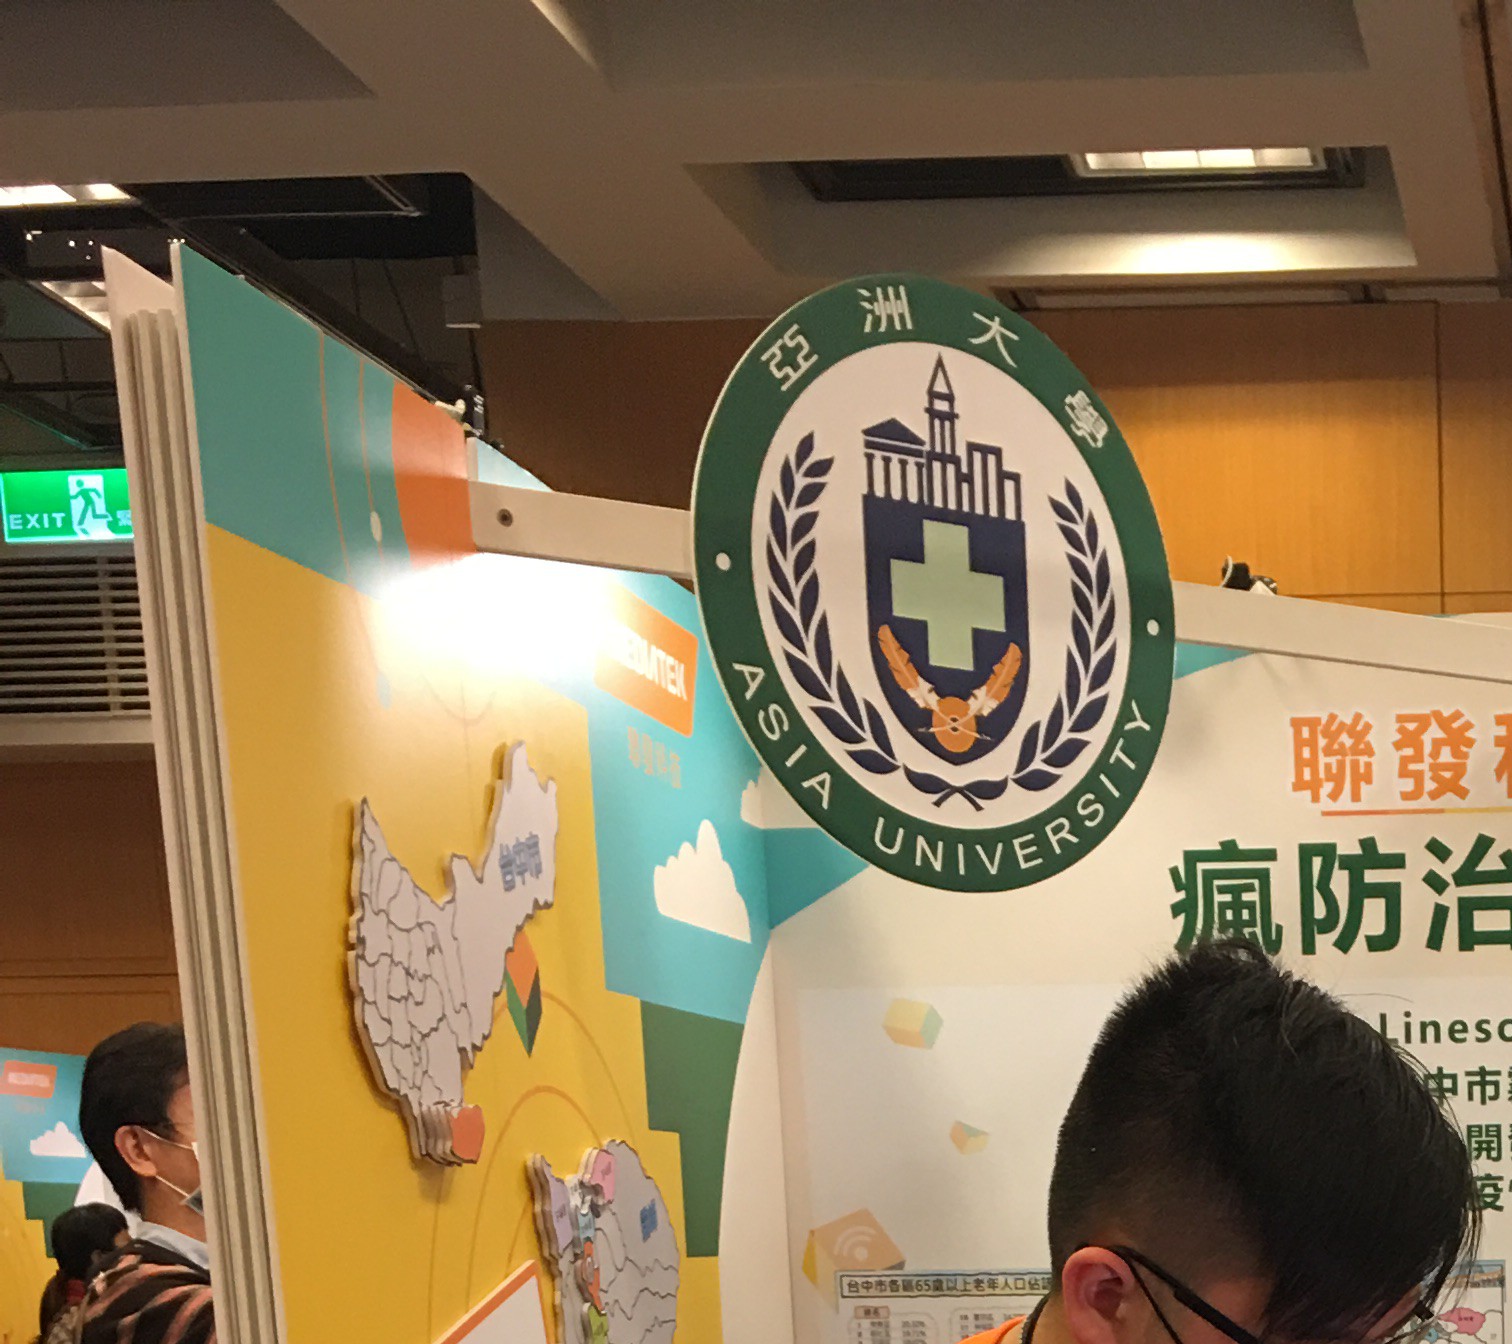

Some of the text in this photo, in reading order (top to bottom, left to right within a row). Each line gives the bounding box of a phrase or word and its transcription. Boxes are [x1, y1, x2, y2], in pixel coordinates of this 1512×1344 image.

[760, 285, 1109, 448] 亞洲大學
[9, 512, 66, 530] EXIT
[732, 661, 1152, 876] ASIA UNIVERSITY
